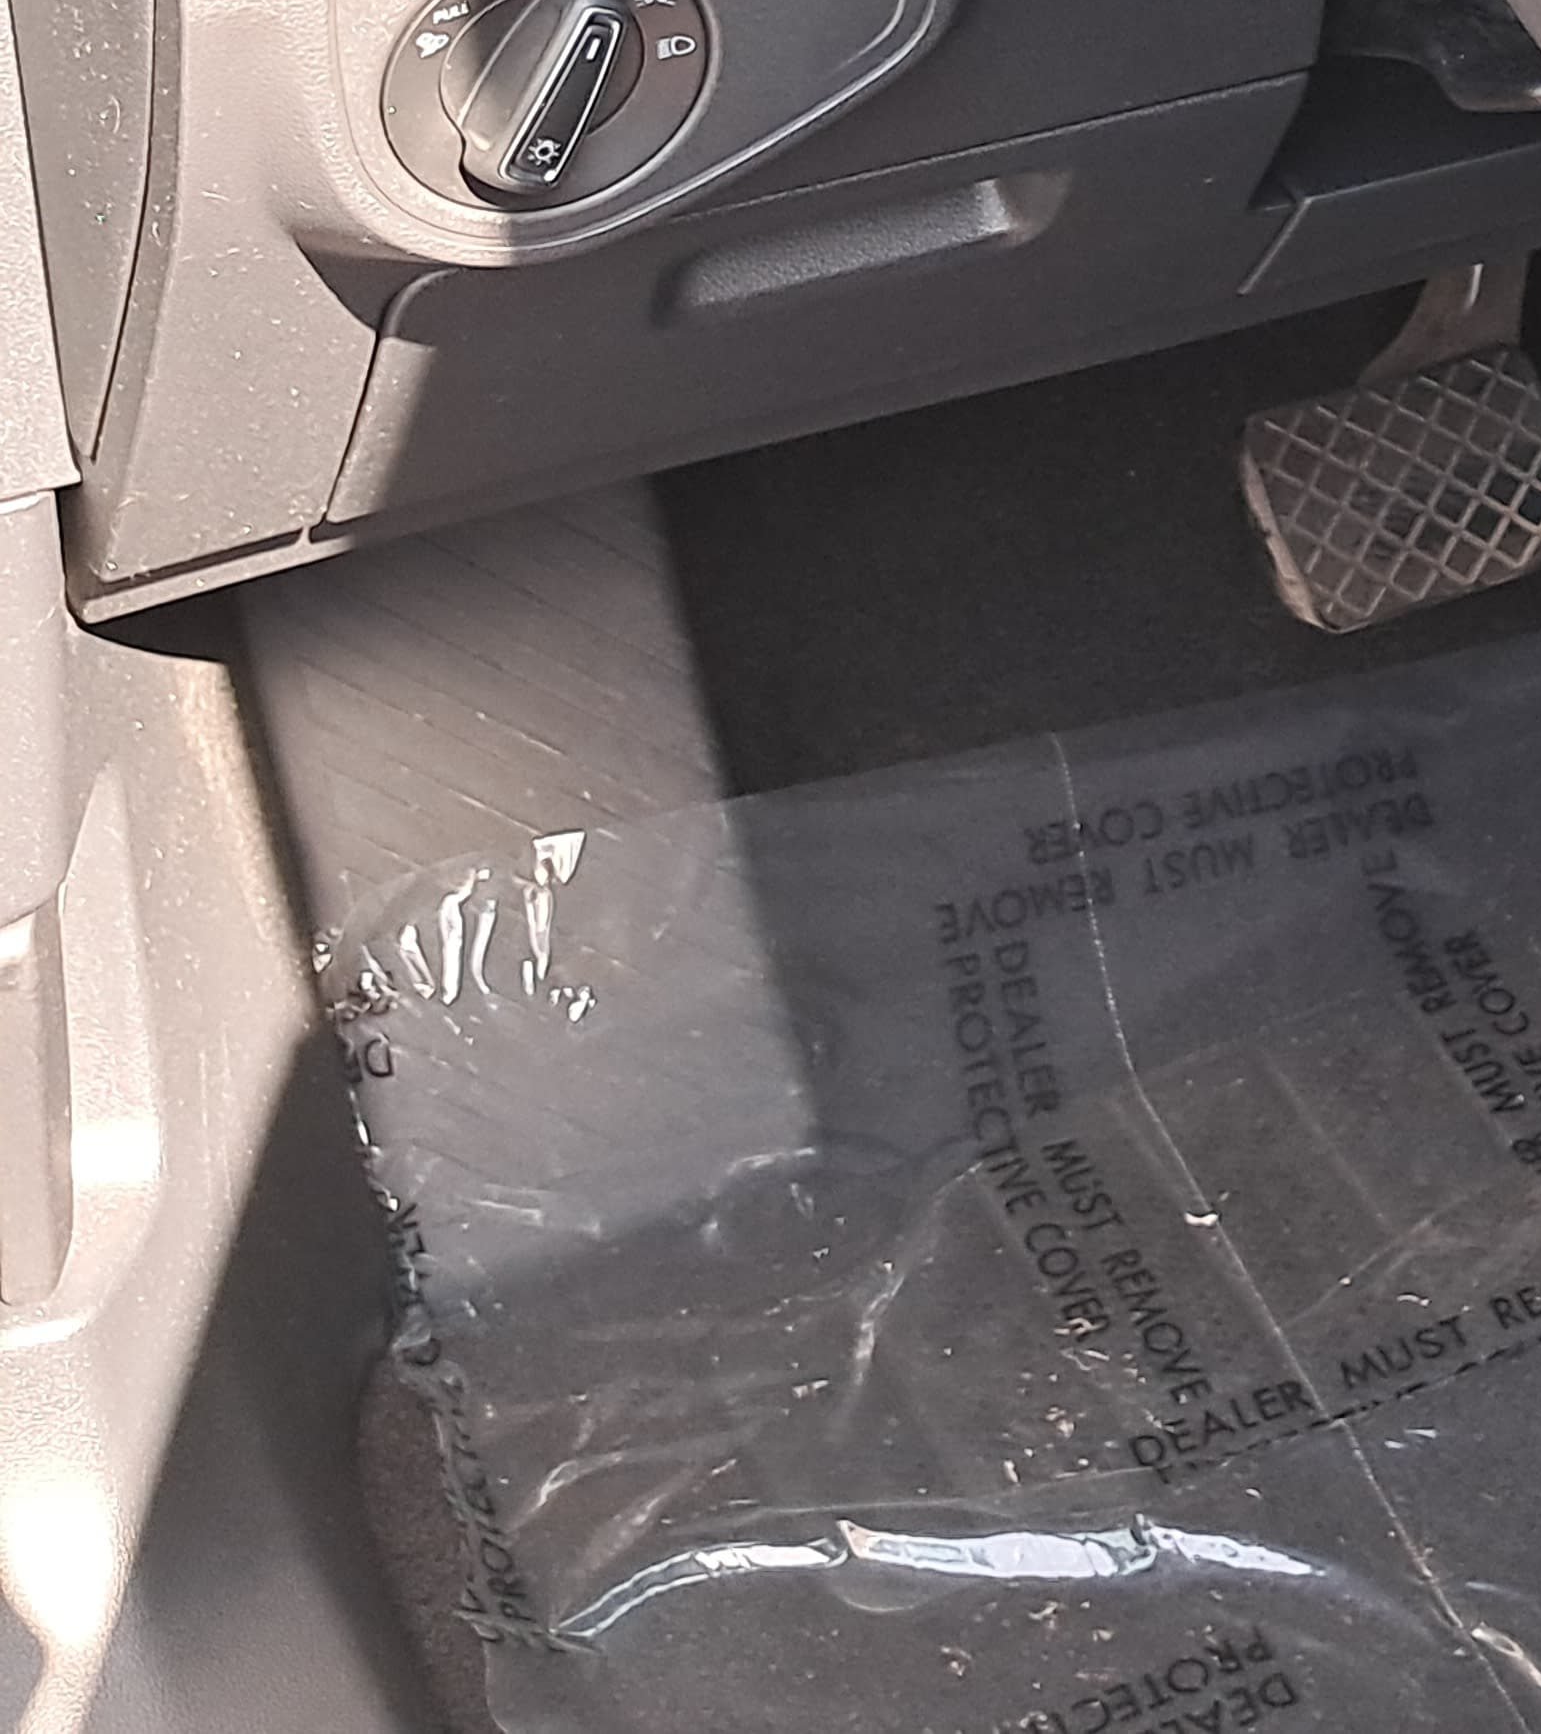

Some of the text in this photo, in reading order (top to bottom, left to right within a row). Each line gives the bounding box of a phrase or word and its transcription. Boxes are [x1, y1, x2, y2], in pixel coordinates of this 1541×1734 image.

[433, 1, 469, 23] PULL
[937, 793, 1434, 943] DEALER MUST REMOVE
[1027, 749, 1422, 865] PROTECTIVE COVER
[1362, 852, 1456, 1015] REMOVE
[1444, 930, 1531, 1037] COVER
[949, 952, 1109, 1341] PROTECTIVE COVER
[1442, 1030, 1525, 1115] MUST
[994, 944, 1212, 1403] DEALER MUST REMOVE
[1128, 1379, 1311, 1472] DEALER
[1339, 1315, 1469, 1391] MUST
